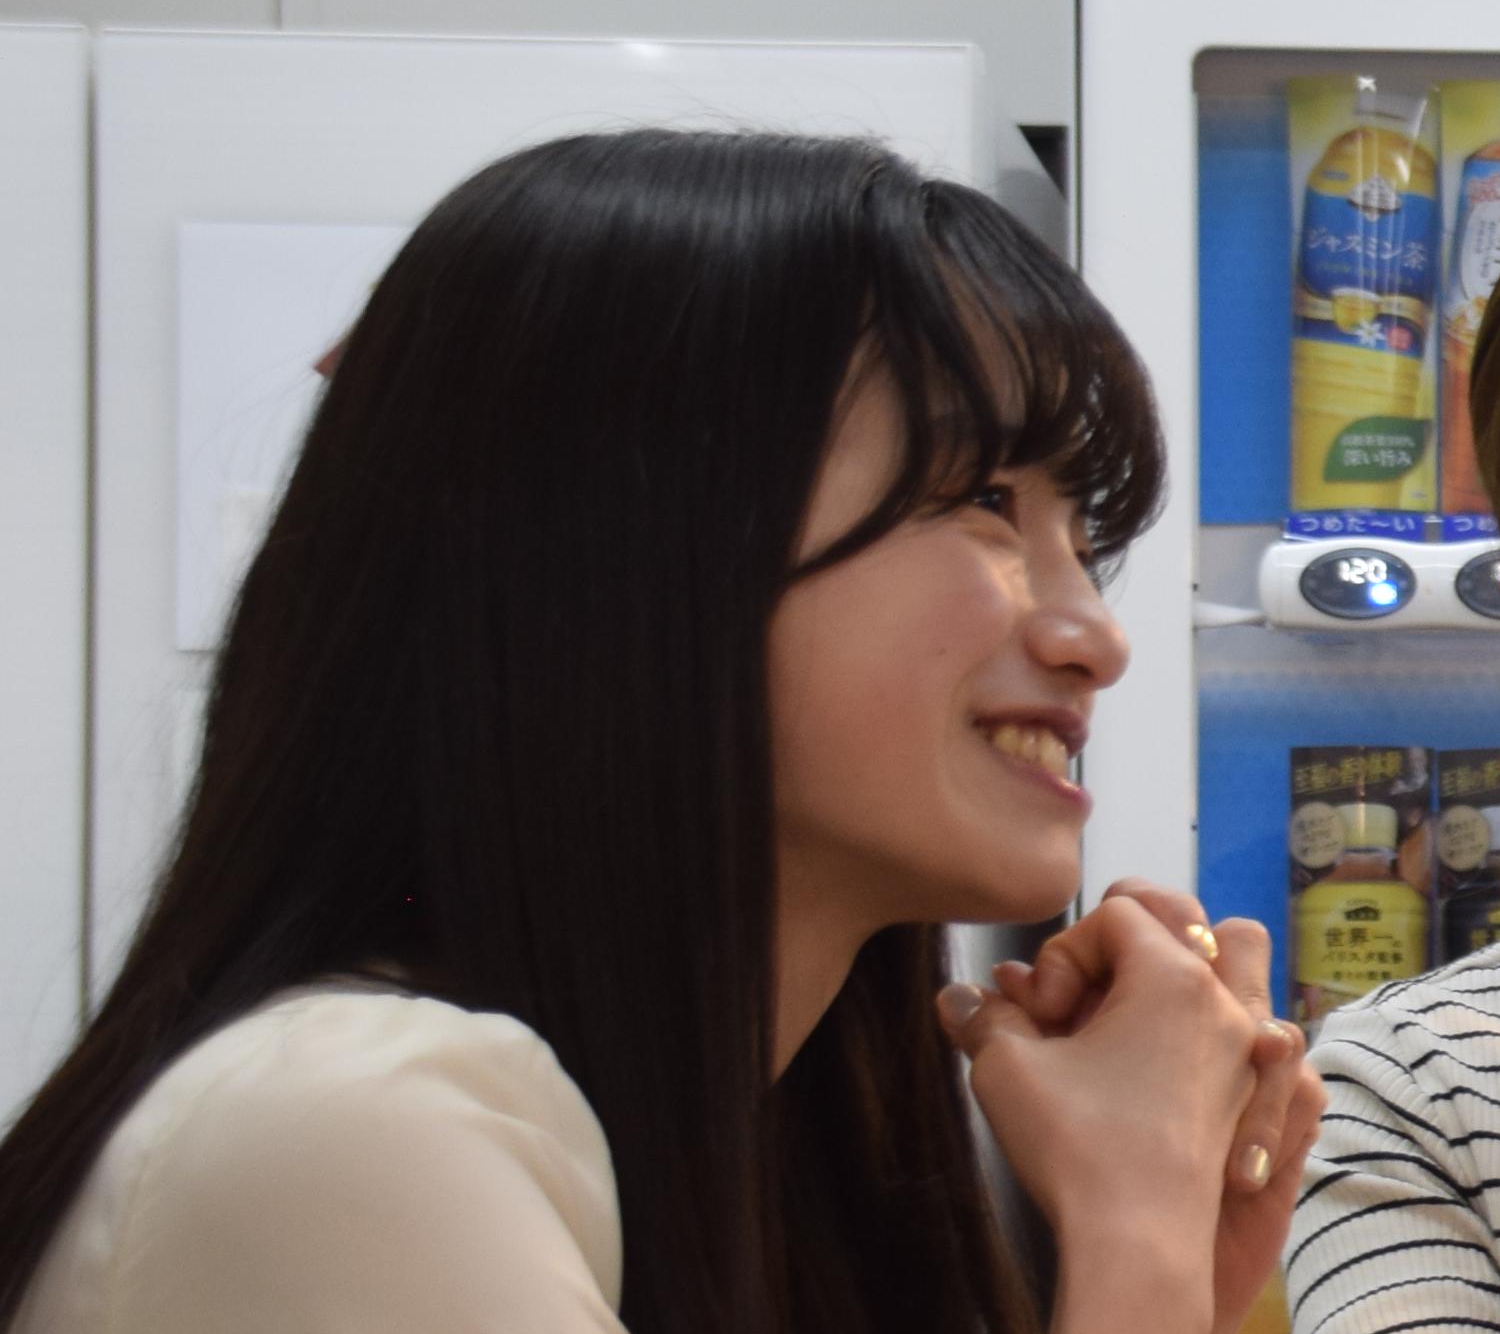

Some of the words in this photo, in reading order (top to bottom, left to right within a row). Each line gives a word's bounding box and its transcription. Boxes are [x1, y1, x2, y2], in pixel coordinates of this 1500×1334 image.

[1308, 225, 1429, 271] ジャスミン茶
[1339, 557, 1388, 585] 120
